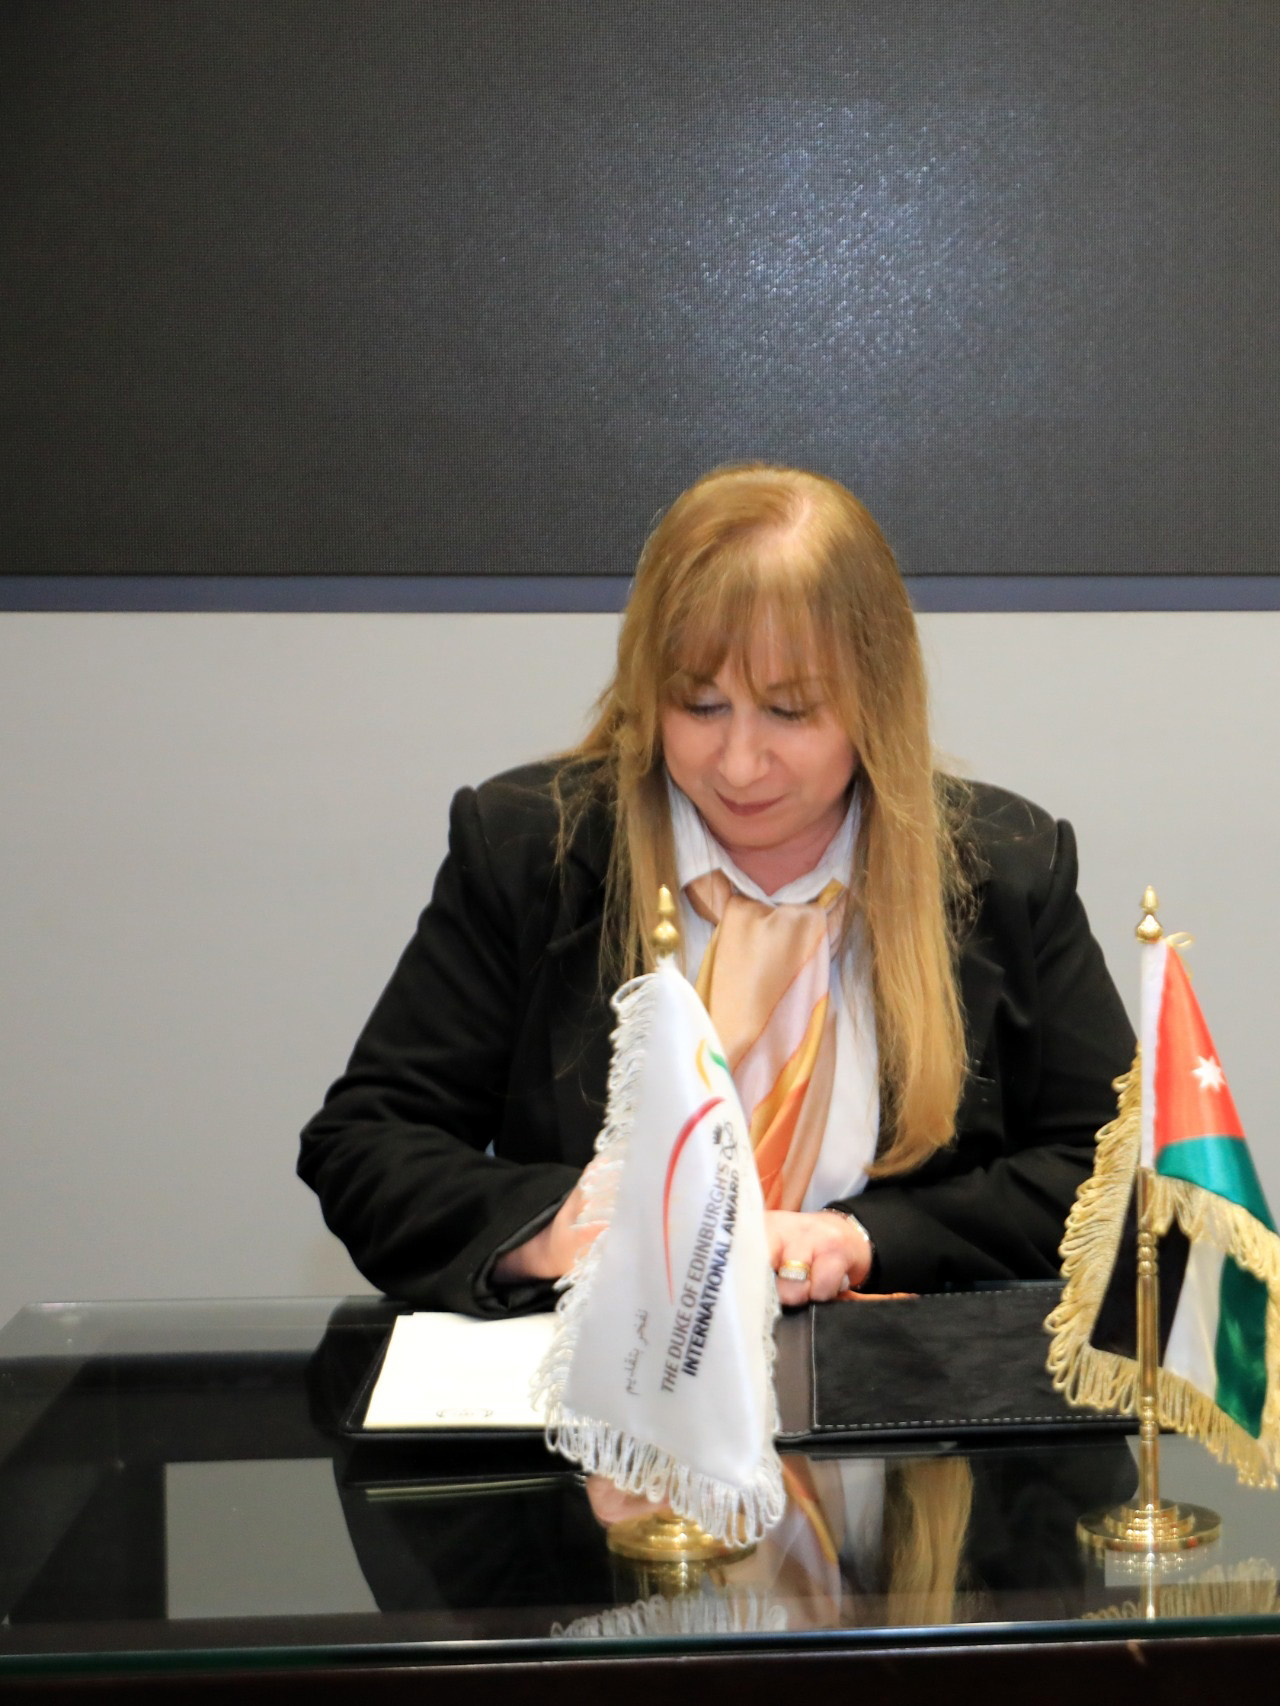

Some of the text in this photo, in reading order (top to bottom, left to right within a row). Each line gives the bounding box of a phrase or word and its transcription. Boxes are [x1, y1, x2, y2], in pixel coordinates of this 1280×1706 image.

[661, 1161, 730, 1393] THE DUKE OF EDINBURGH'S
[681, 1168, 740, 1377] INTERNATIONAL AWARD
